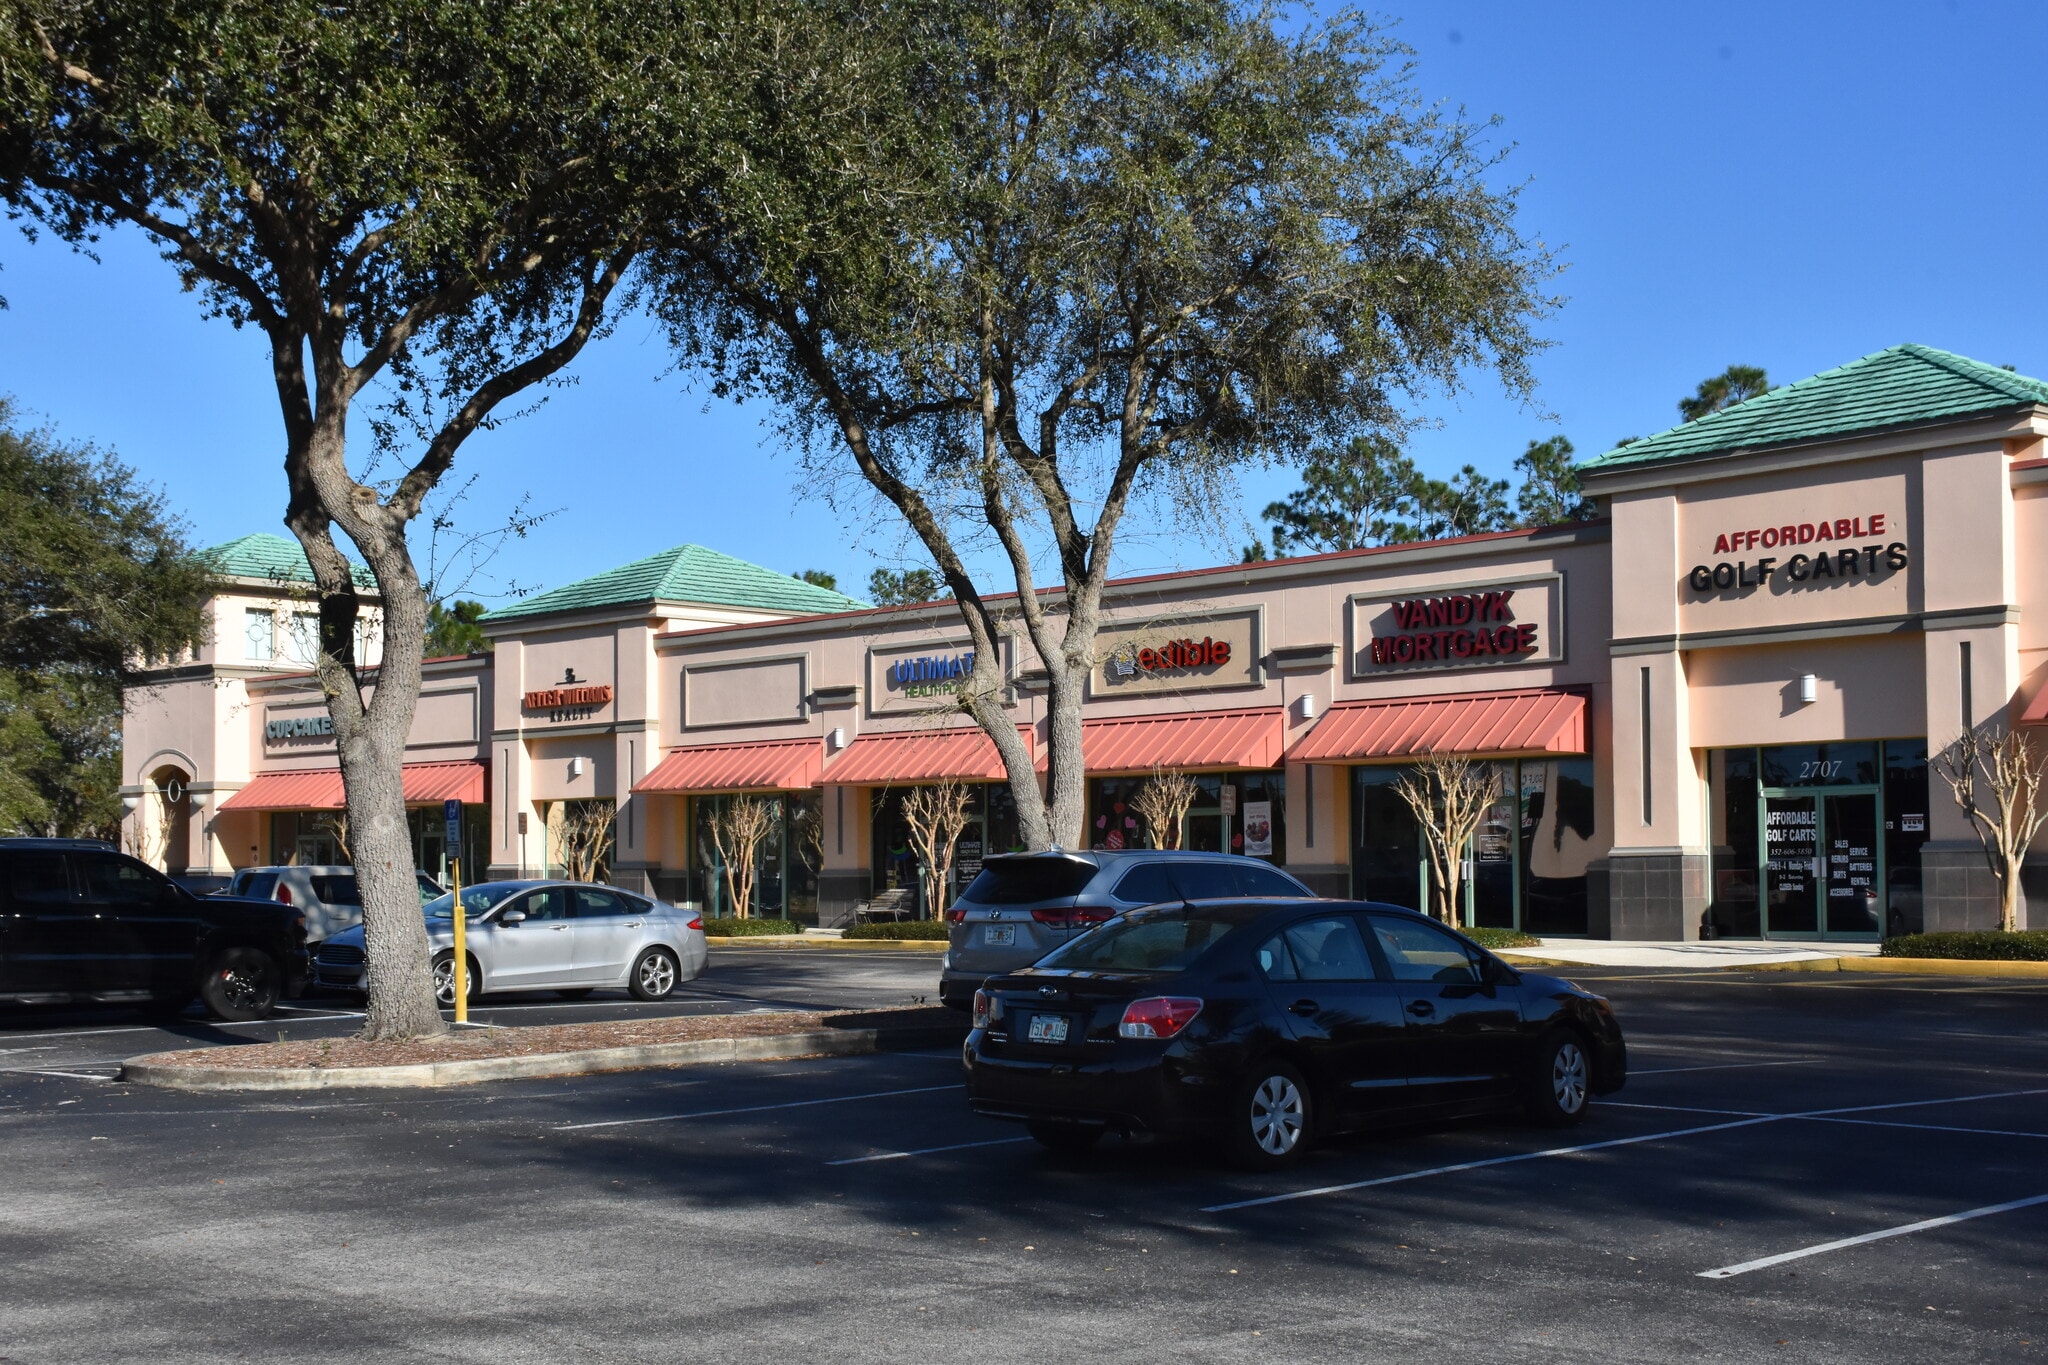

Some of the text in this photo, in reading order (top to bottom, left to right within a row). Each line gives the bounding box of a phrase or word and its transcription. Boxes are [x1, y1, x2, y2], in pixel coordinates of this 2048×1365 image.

[1713, 514, 1885, 554] AFFORDABLE
[1690, 542, 1908, 592] GOLF CARTS
[1391, 590, 1515, 630] VANDYK
[1372, 623, 1538, 665] MORTGAGE
[1138, 636, 1231, 671] edible
[895, 652, 975, 683] ULTIMAT
[905, 683, 961, 698] HEALTH PLA
[550, 707, 594, 723] REALTY
[1800, 760, 1842, 778] 2707
[1766, 811, 1816, 825] AFFORDABLE
[1767, 829, 1816, 842] GOLF CARTS
[1834, 839, 1849, 849] SALES
[1849, 847, 1868, 856] SERVICE
[1849, 862, 1873, 872] BATTERIES
[1850, 877, 1870, 886] RENTALS
